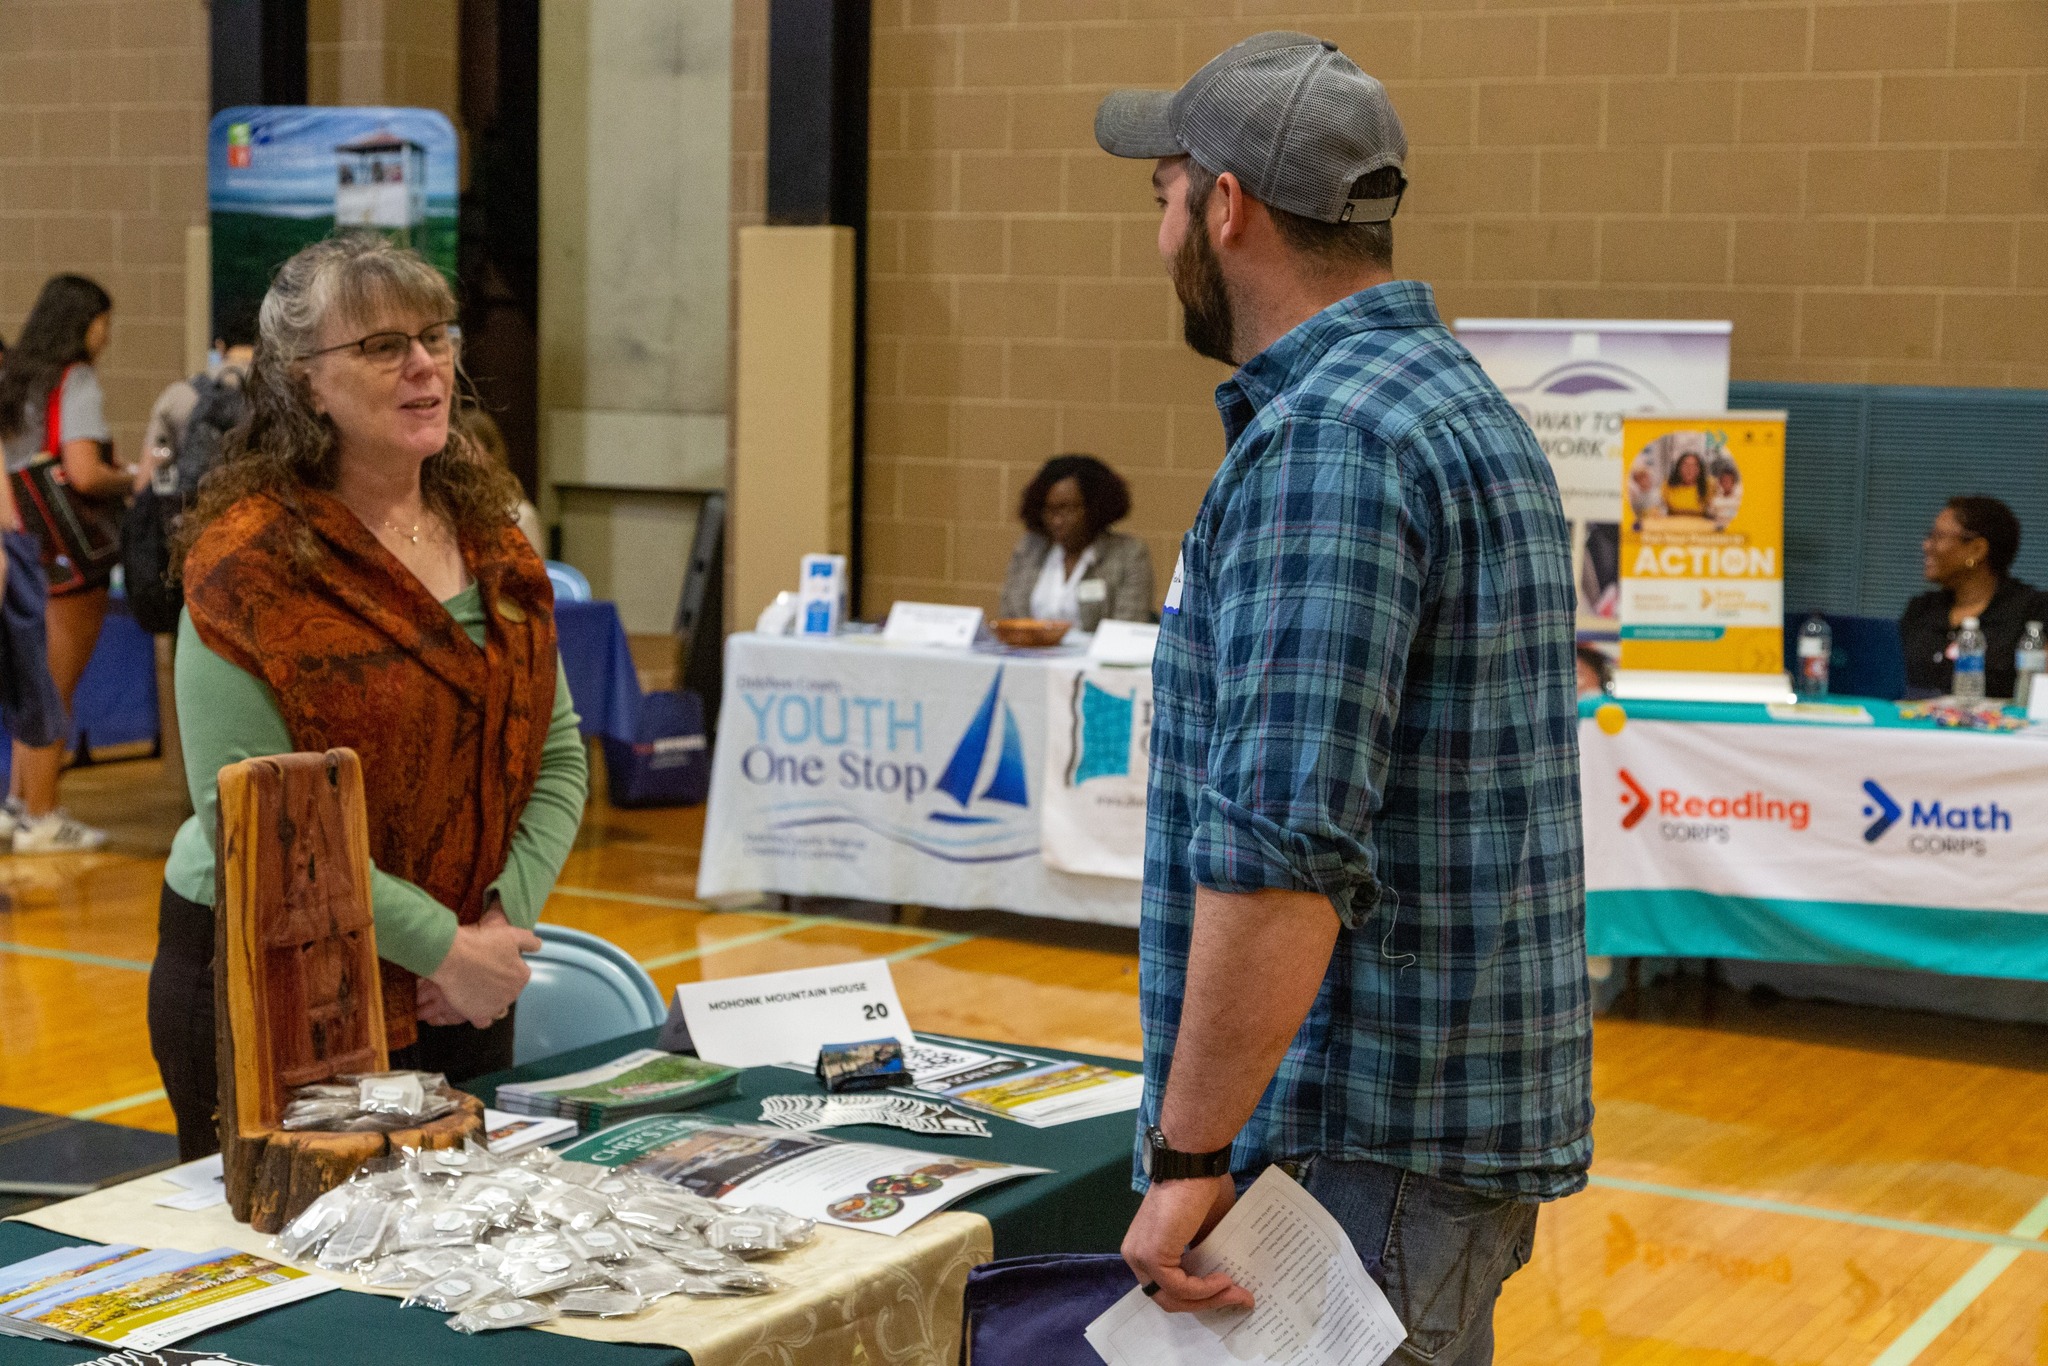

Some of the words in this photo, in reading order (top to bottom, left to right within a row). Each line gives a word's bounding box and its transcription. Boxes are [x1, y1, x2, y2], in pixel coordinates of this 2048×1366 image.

[1536, 411, 1586, 431] WAY
[1590, 412, 1624, 434] TO
[1633, 546, 1775, 576] ACTION
[741, 691, 924, 753] YOUTH
[741, 744, 825, 787] One
[838, 750, 929, 803] Stop
[1658, 788, 1811, 831] Reading
[1910, 799, 2011, 832] Math
[1660, 821, 1730, 844] CORPS
[1908, 834, 1987, 857] CORPS
[708, 996, 763, 1012] MOHONK
[764, 988, 828, 1005] MOUNTAIN
[829, 982, 869, 996] HOUSE
[862, 1002, 889, 1021] 20
